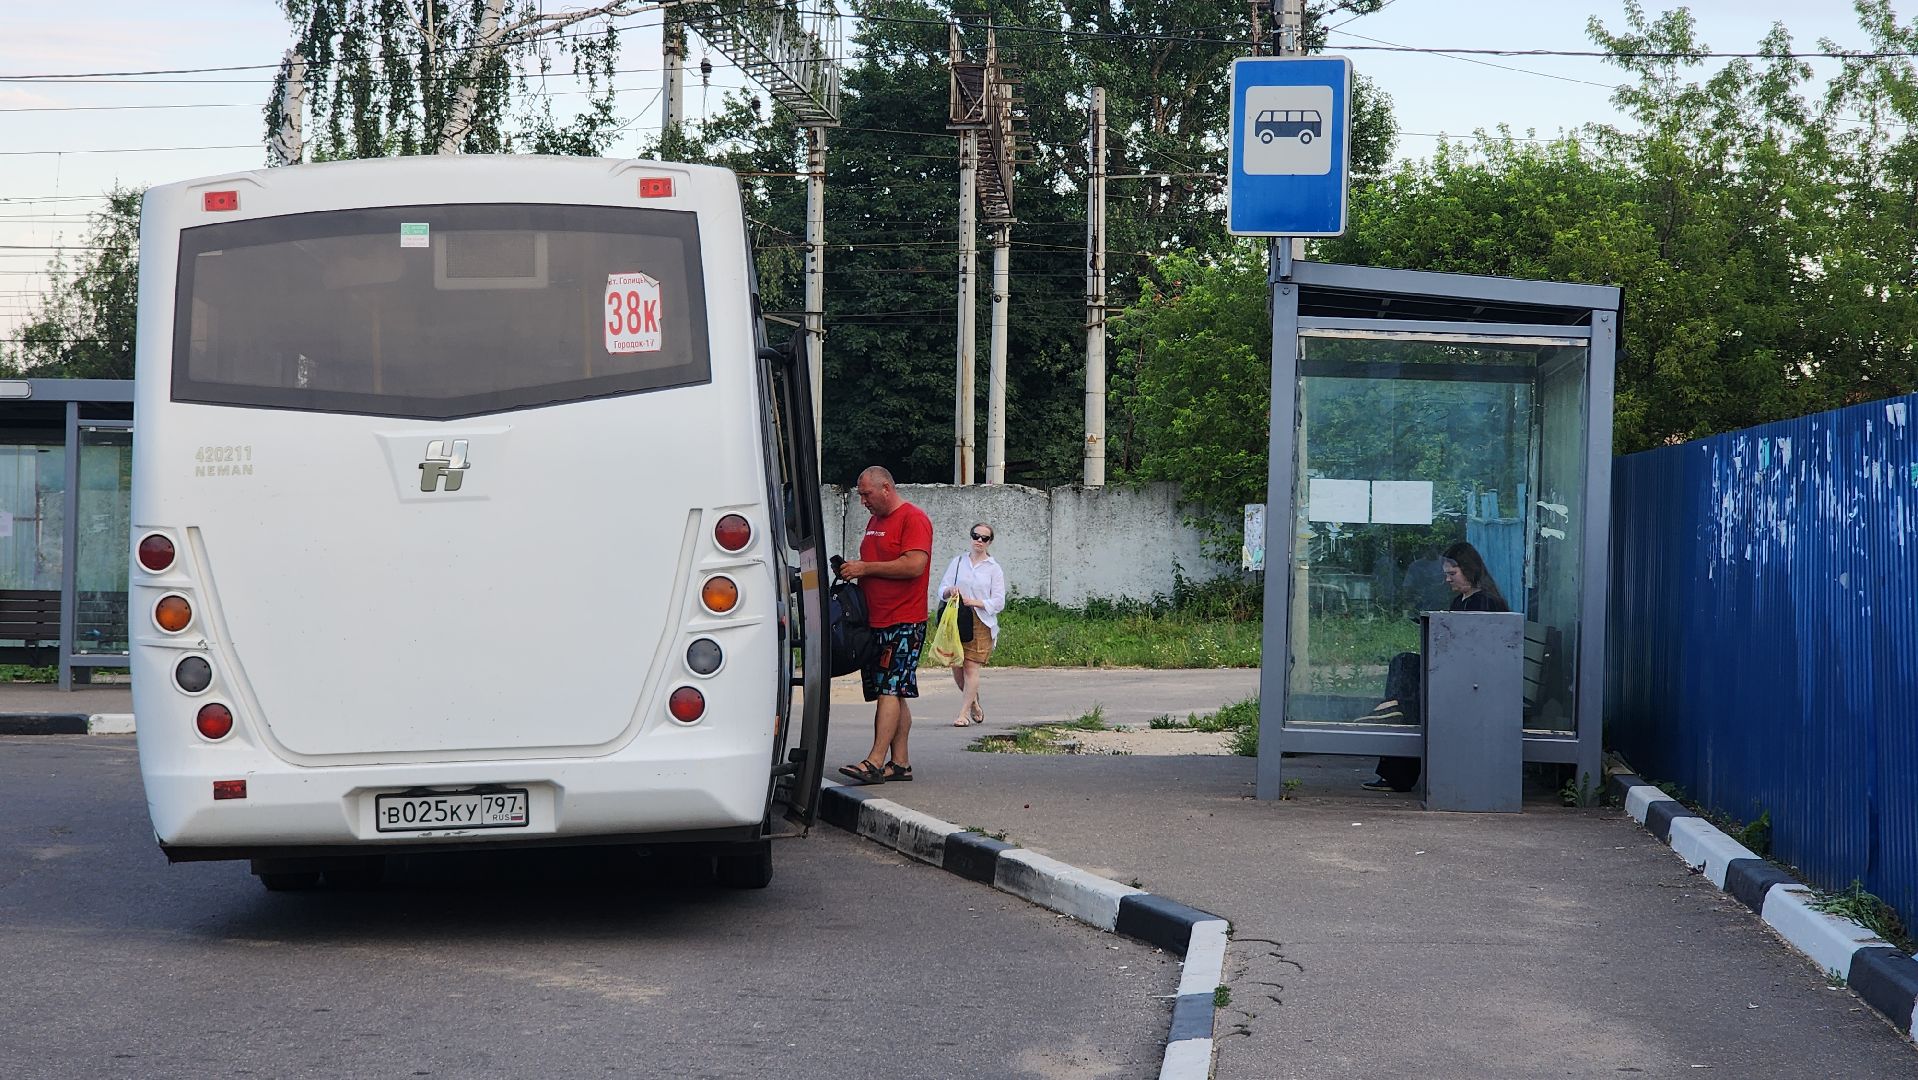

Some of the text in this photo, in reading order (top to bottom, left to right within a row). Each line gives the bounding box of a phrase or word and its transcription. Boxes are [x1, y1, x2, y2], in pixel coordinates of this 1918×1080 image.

[195, 446, 252, 462] 420211
[195, 464, 253, 477] NEMAN
[483, 796, 517, 814] 797
[492, 813, 511, 821] RUS
